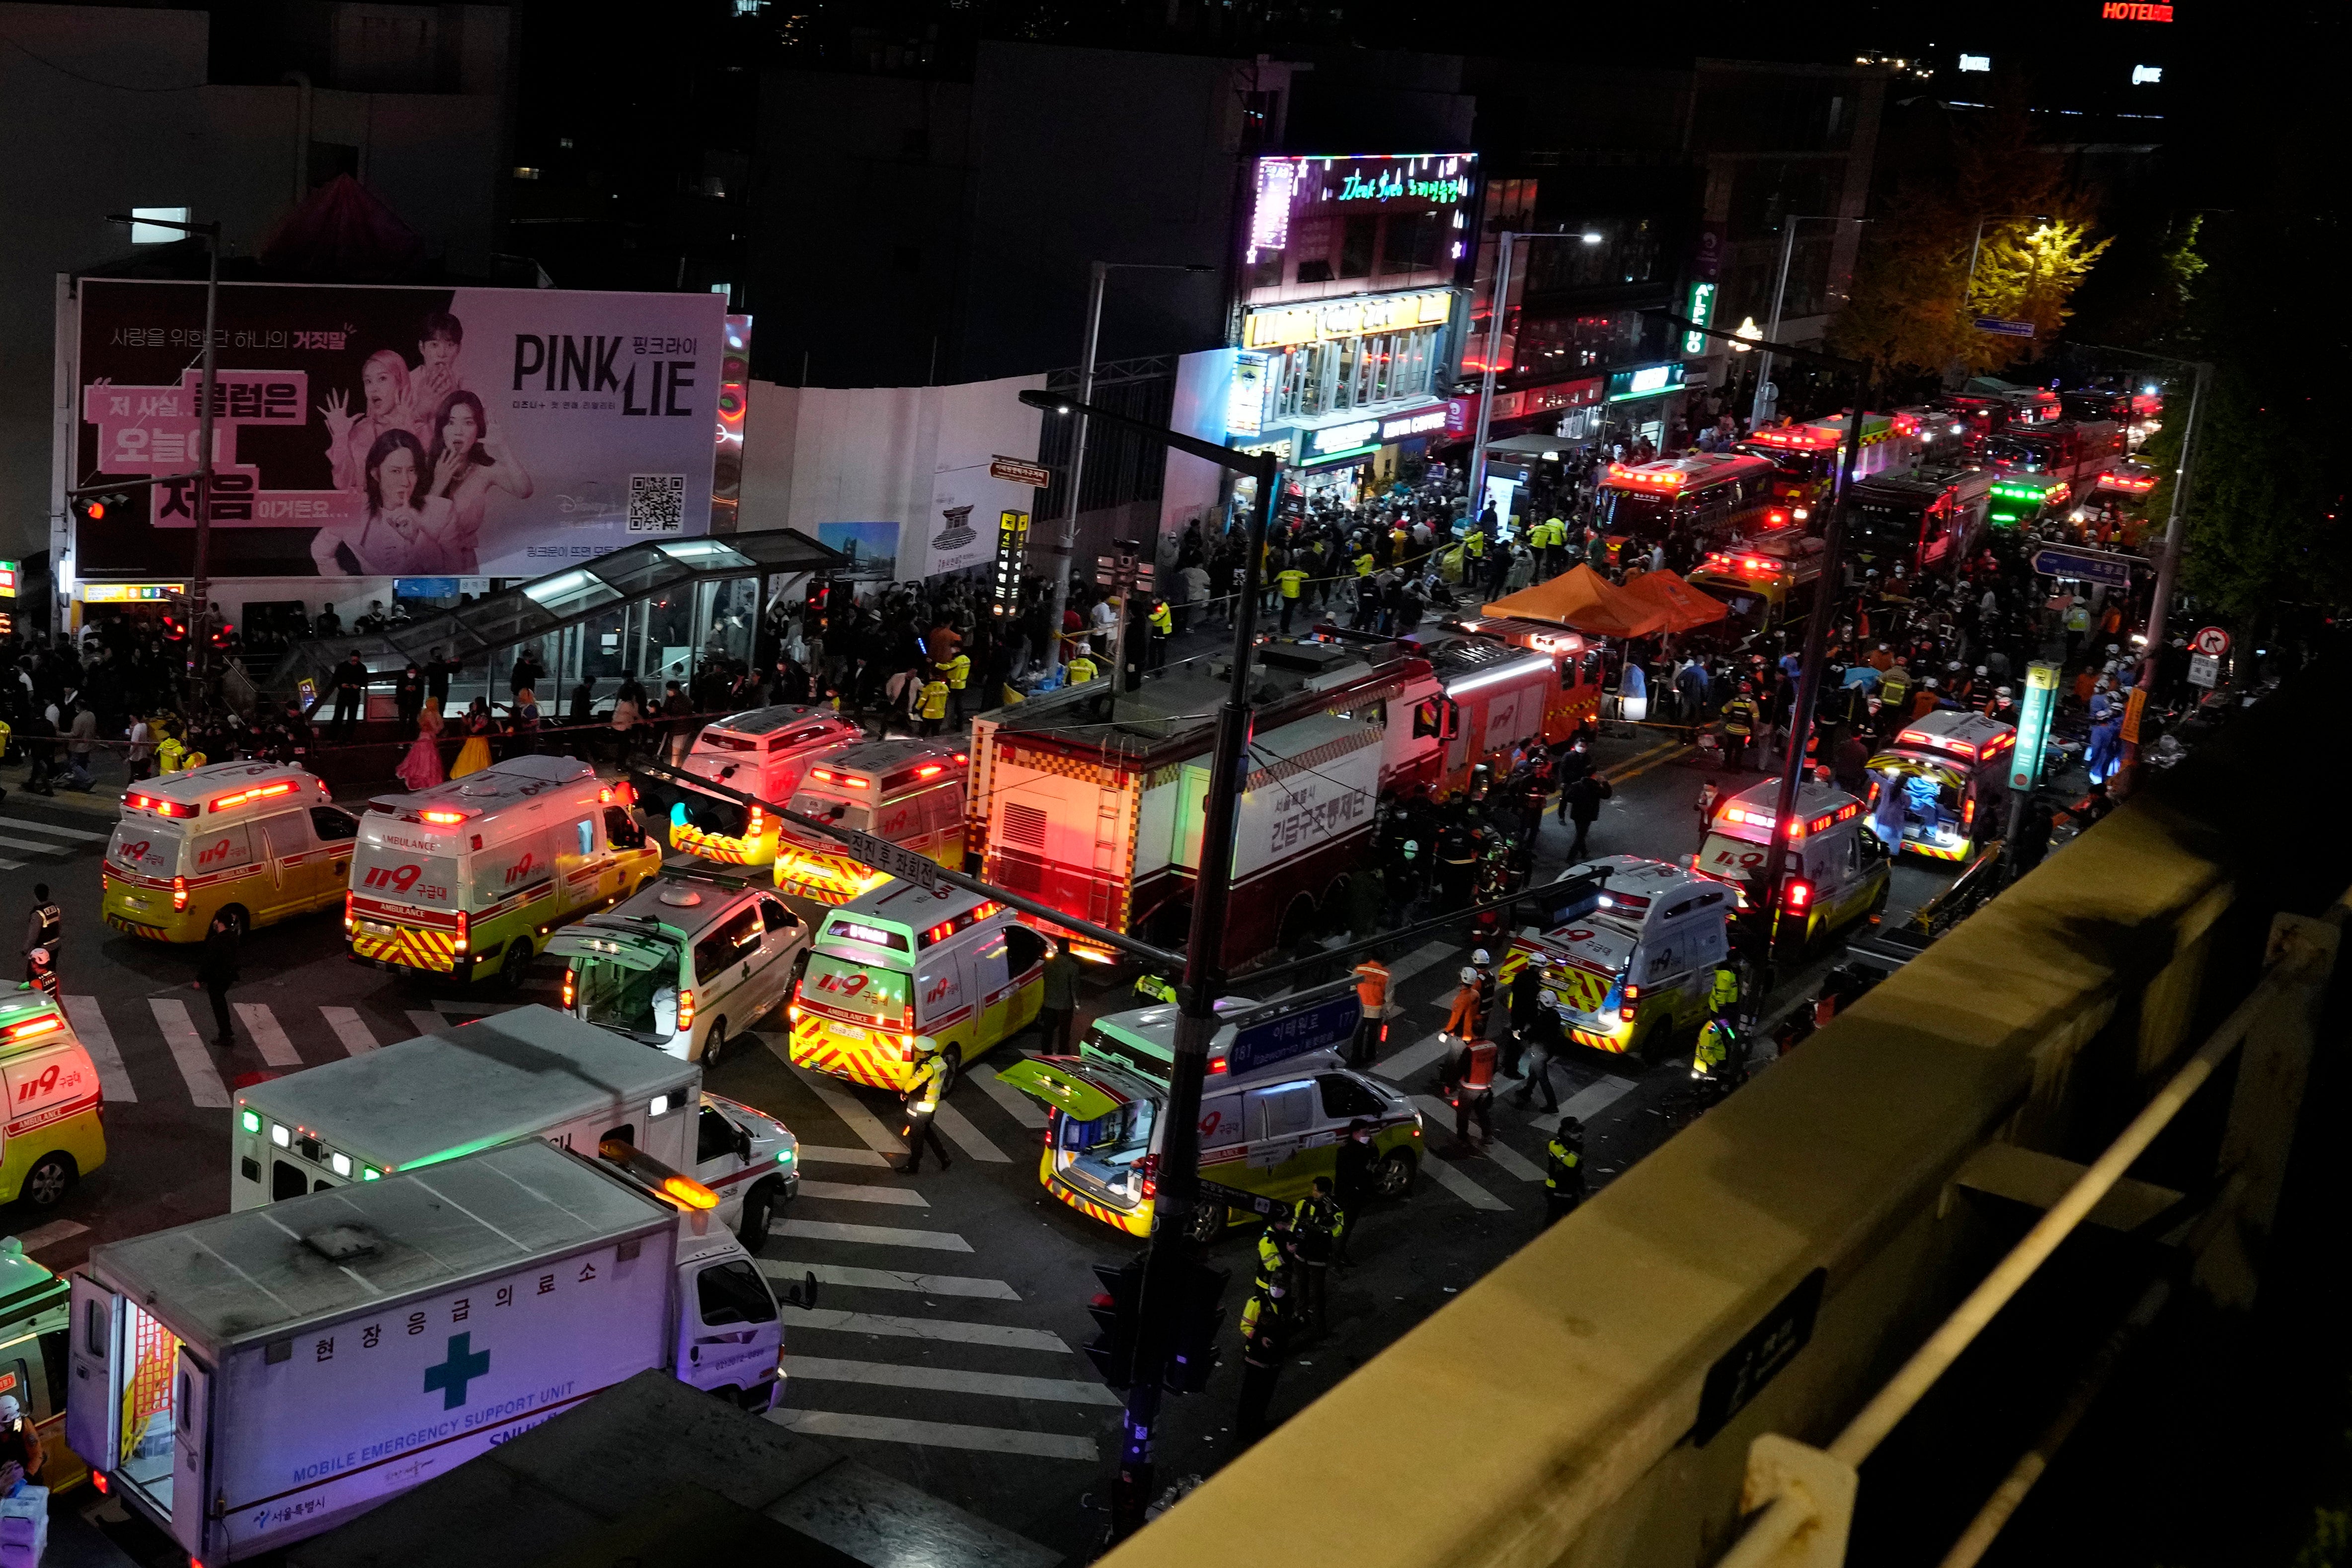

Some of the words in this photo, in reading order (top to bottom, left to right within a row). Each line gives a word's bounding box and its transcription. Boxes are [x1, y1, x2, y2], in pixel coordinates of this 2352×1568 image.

[110, 328, 165, 346] 사랑을
[170, 329, 206, 347] 위한
[235, 330, 288, 349] 하나의
[293, 330, 347, 350] 거짓말
[632, 337, 697, 355] 핑크라이
[512, 334, 623, 392] PINK
[623, 361, 696, 416] LIE
[109, 396, 130, 416] 저
[115, 428, 221, 463] 오늘이
[571, 546, 591, 557] 뜨면
[117, 841, 151, 861] 119
[198, 839, 231, 864] 119
[382, 834, 436, 851] AMBULANCE
[851, 835, 876, 863] 직진
[878, 845, 890, 868] 후
[896, 853, 934, 887] 좌회전
[1713, 850, 1764, 870] 119
[362, 864, 422, 895] 119
[416, 883, 447, 901] 구급대
[380, 903, 426, 918] AMBULANCE
[1548, 927, 1595, 942] 19
[815, 973, 869, 998] 119
[827, 1008, 869, 1023] AMBULANCE
[1273, 1014, 1319, 1041] 이태원로
[1338, 1010, 1356, 1028] 177
[1234, 1043, 1252, 1062] 181
[16, 1064, 60, 1104] 119
[59, 1070, 82, 1089] 구급대
[18, 1107, 63, 1130] AMBULANCE
[293, 1451, 356, 1483] MOBILE
[361, 1420, 459, 1463] EMERGENCY
[465, 1394, 537, 1429] SUPPORT
[539, 1380, 577, 1404] UNIT
[271, 1495, 326, 1523] 서울특별시
